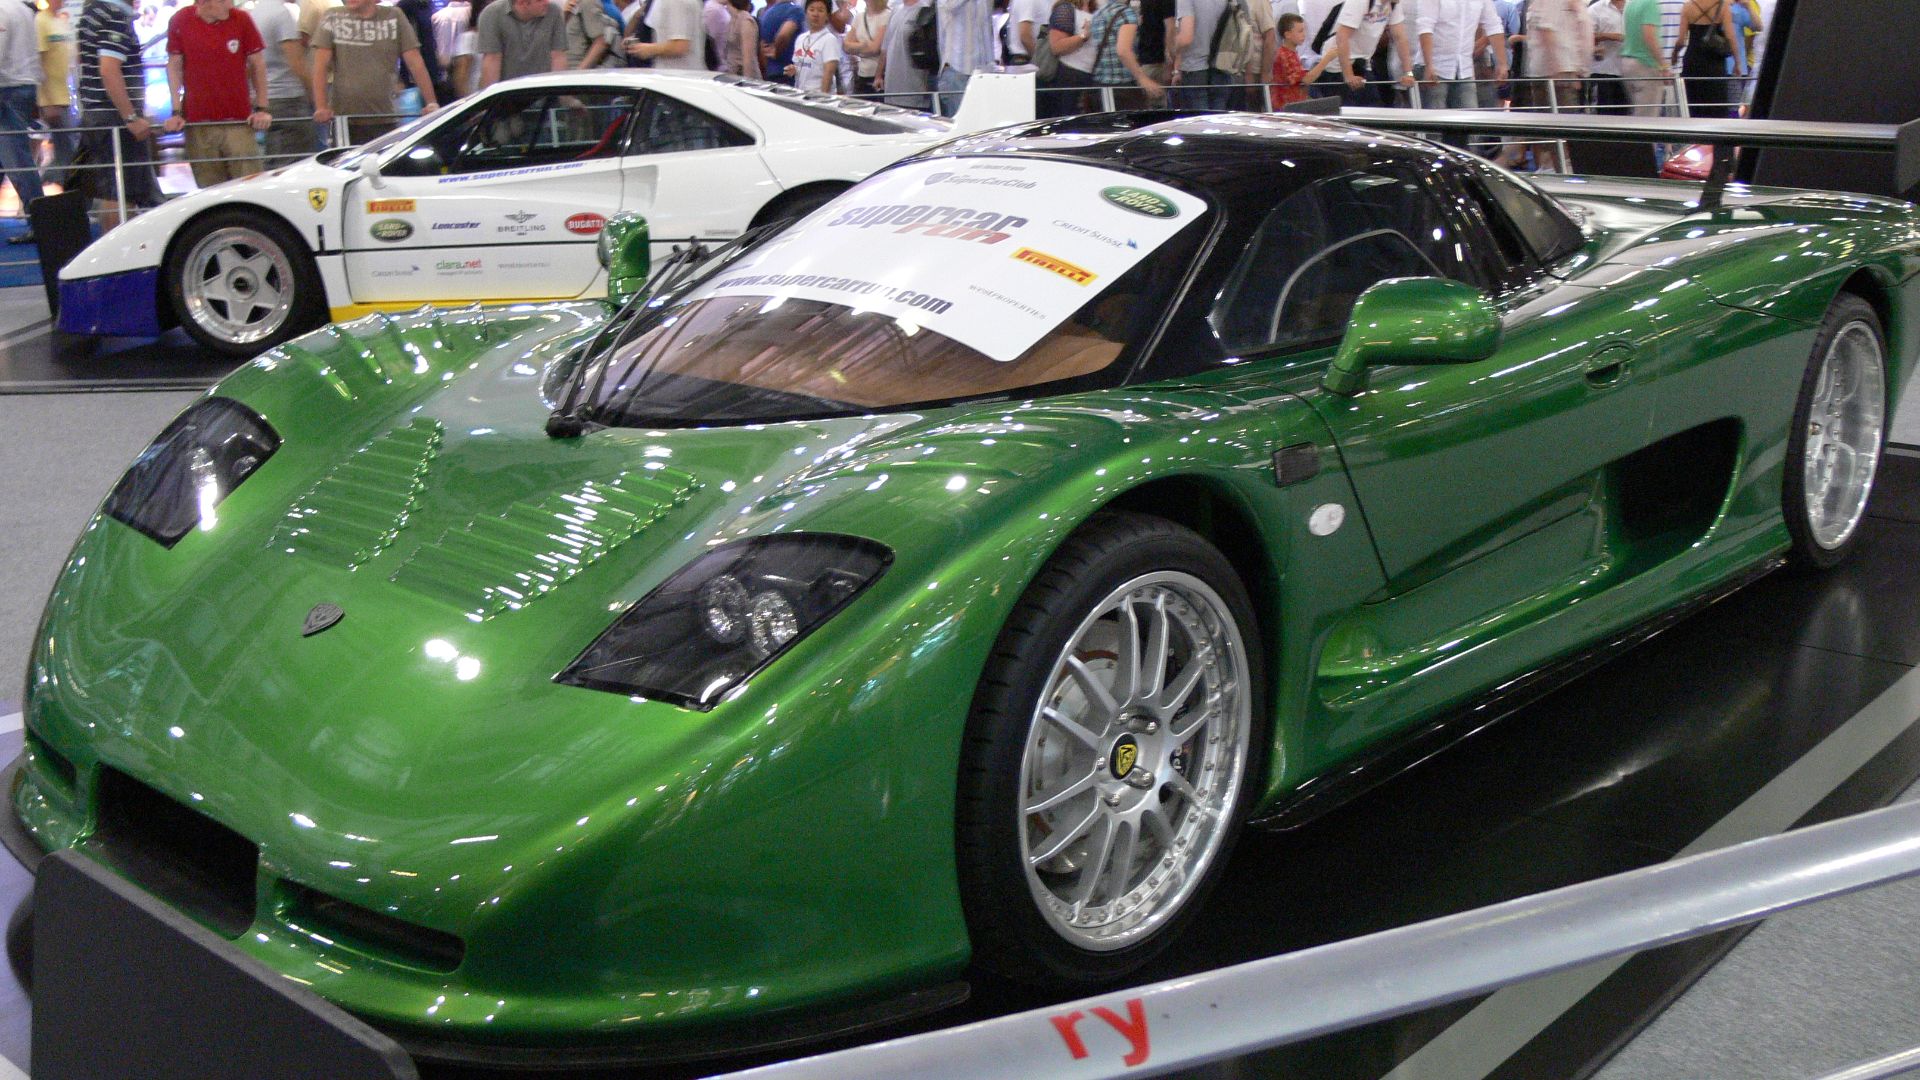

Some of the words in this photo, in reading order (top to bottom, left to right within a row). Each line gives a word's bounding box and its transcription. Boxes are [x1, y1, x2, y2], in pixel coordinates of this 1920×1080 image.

[1114, 196, 1165, 215] ROVER
[1118, 189, 1161, 204] LAND
[568, 219, 604, 229] BUGATTI
[827, 204, 1029, 232] supercar
[497, 224, 546, 232] BREITLING
[892, 222, 1012, 245] run
[436, 259, 482, 270] clara.net
[1016, 249, 1092, 283] PIRELLI
[1048, 998, 1151, 1068] ry
